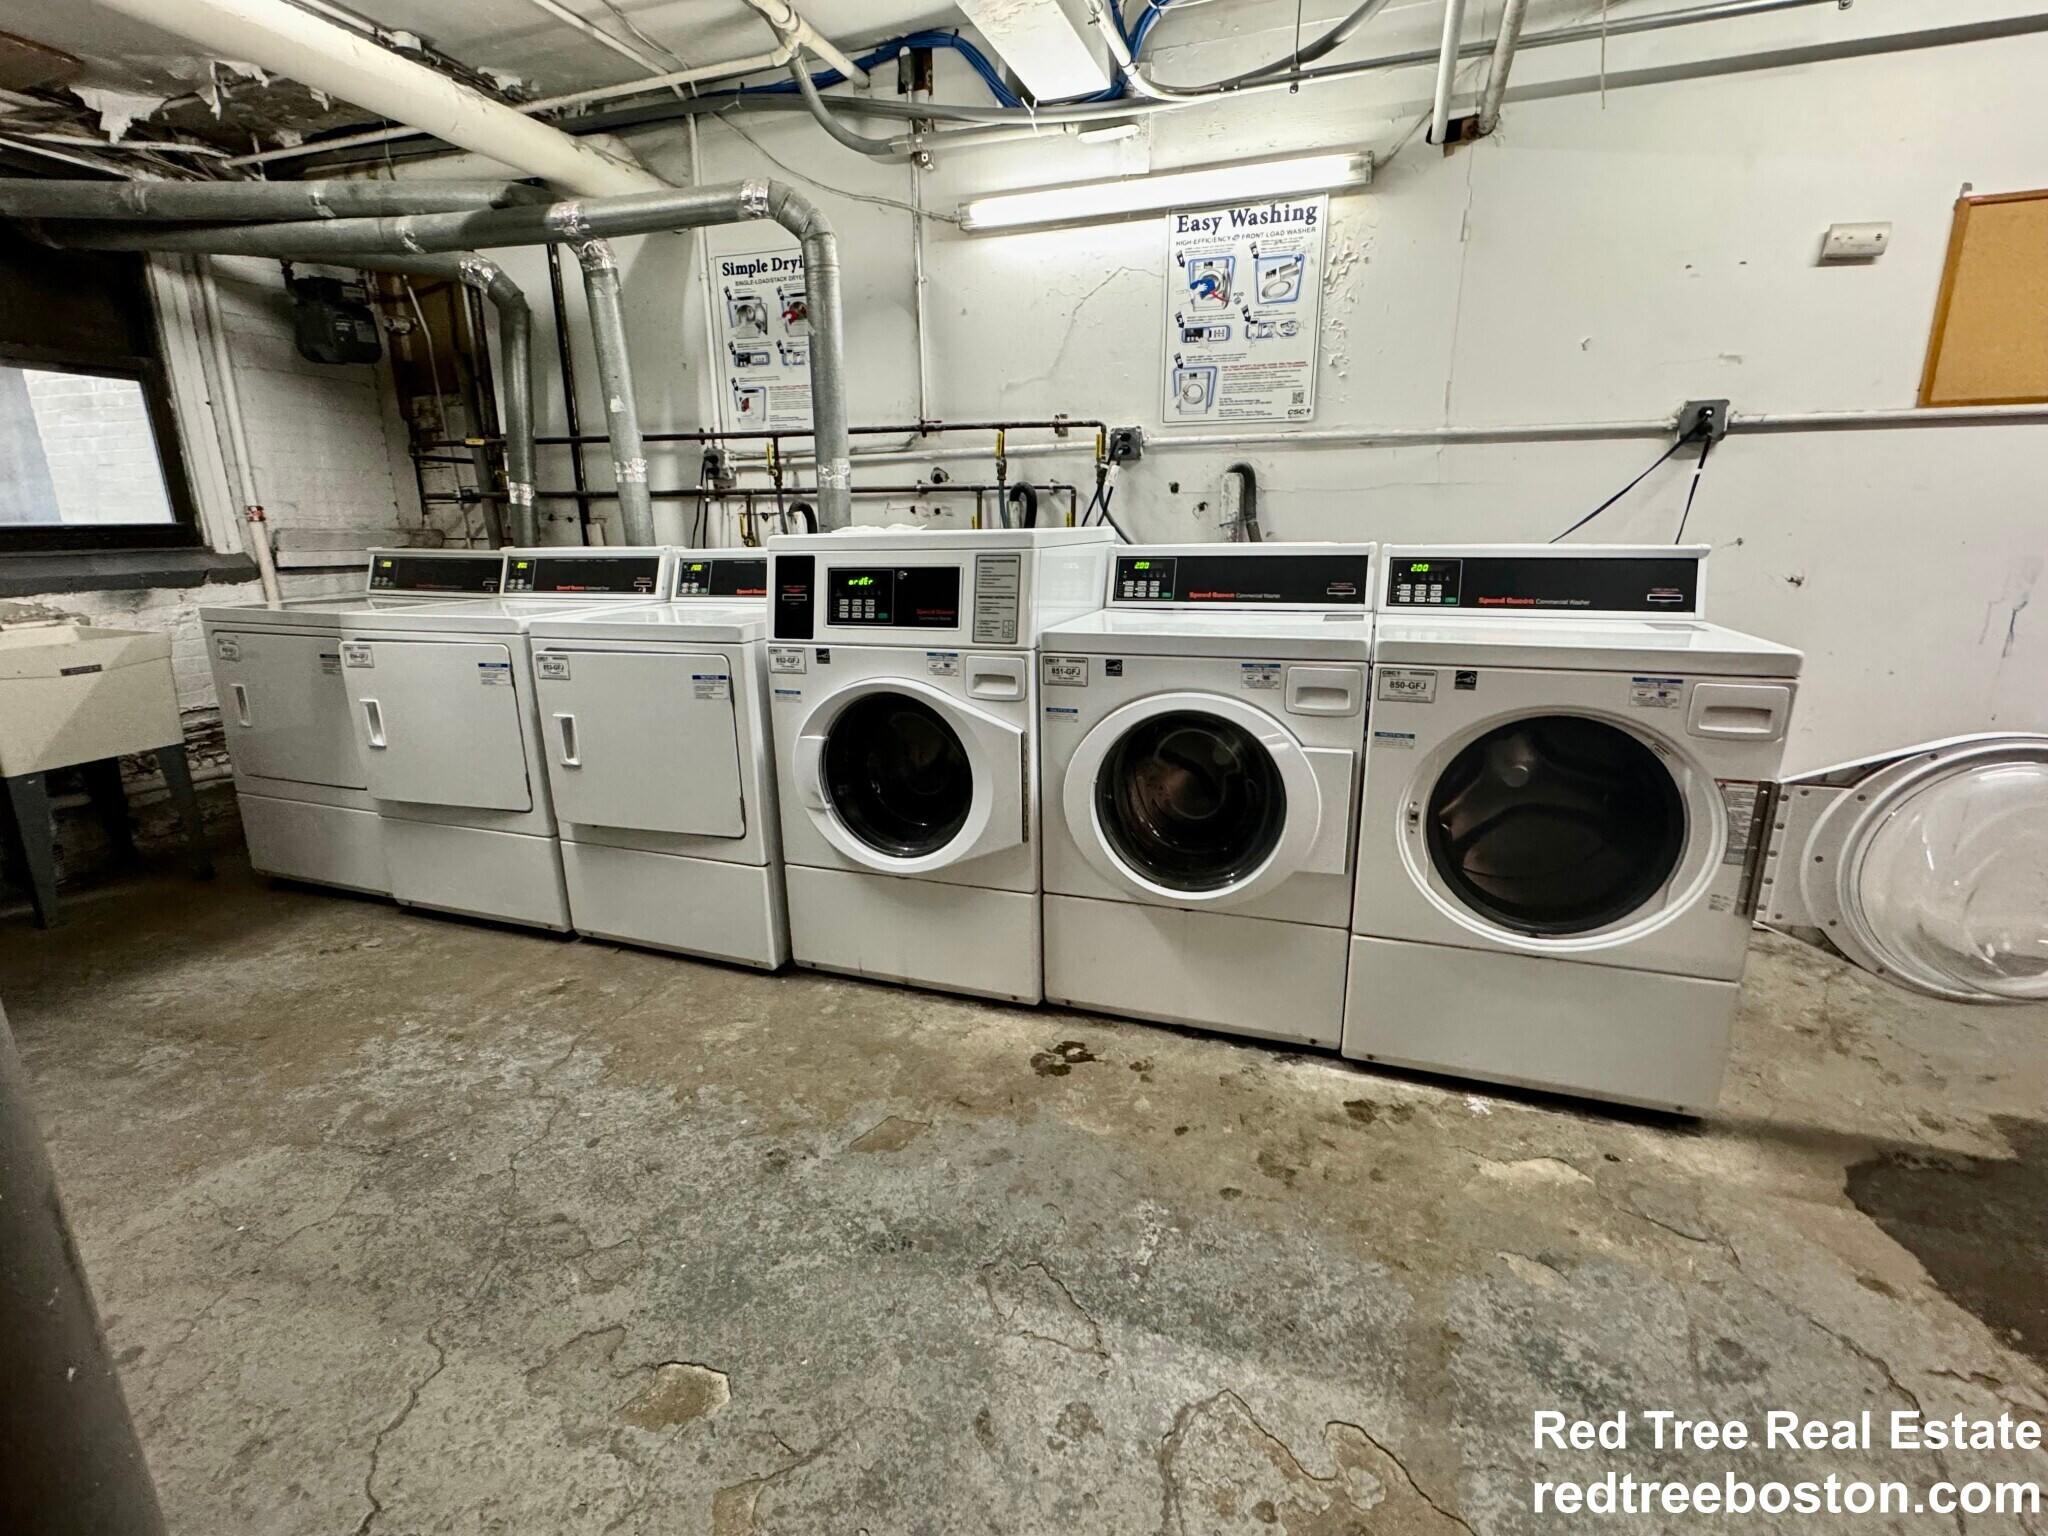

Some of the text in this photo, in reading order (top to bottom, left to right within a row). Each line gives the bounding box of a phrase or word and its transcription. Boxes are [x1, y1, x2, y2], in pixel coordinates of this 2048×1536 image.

[1176, 203, 1319, 236] Easy Washing
[1241, 232, 1265, 240] FRONT
[1265, 229, 1285, 238] LOAD
[1286, 226, 1317, 236] WASHER
[722, 254, 804, 278] Simple Dryi
[1051, 667, 1081, 676] 851-GFJ
[1389, 680, 1427, 690] 850-GFJ
